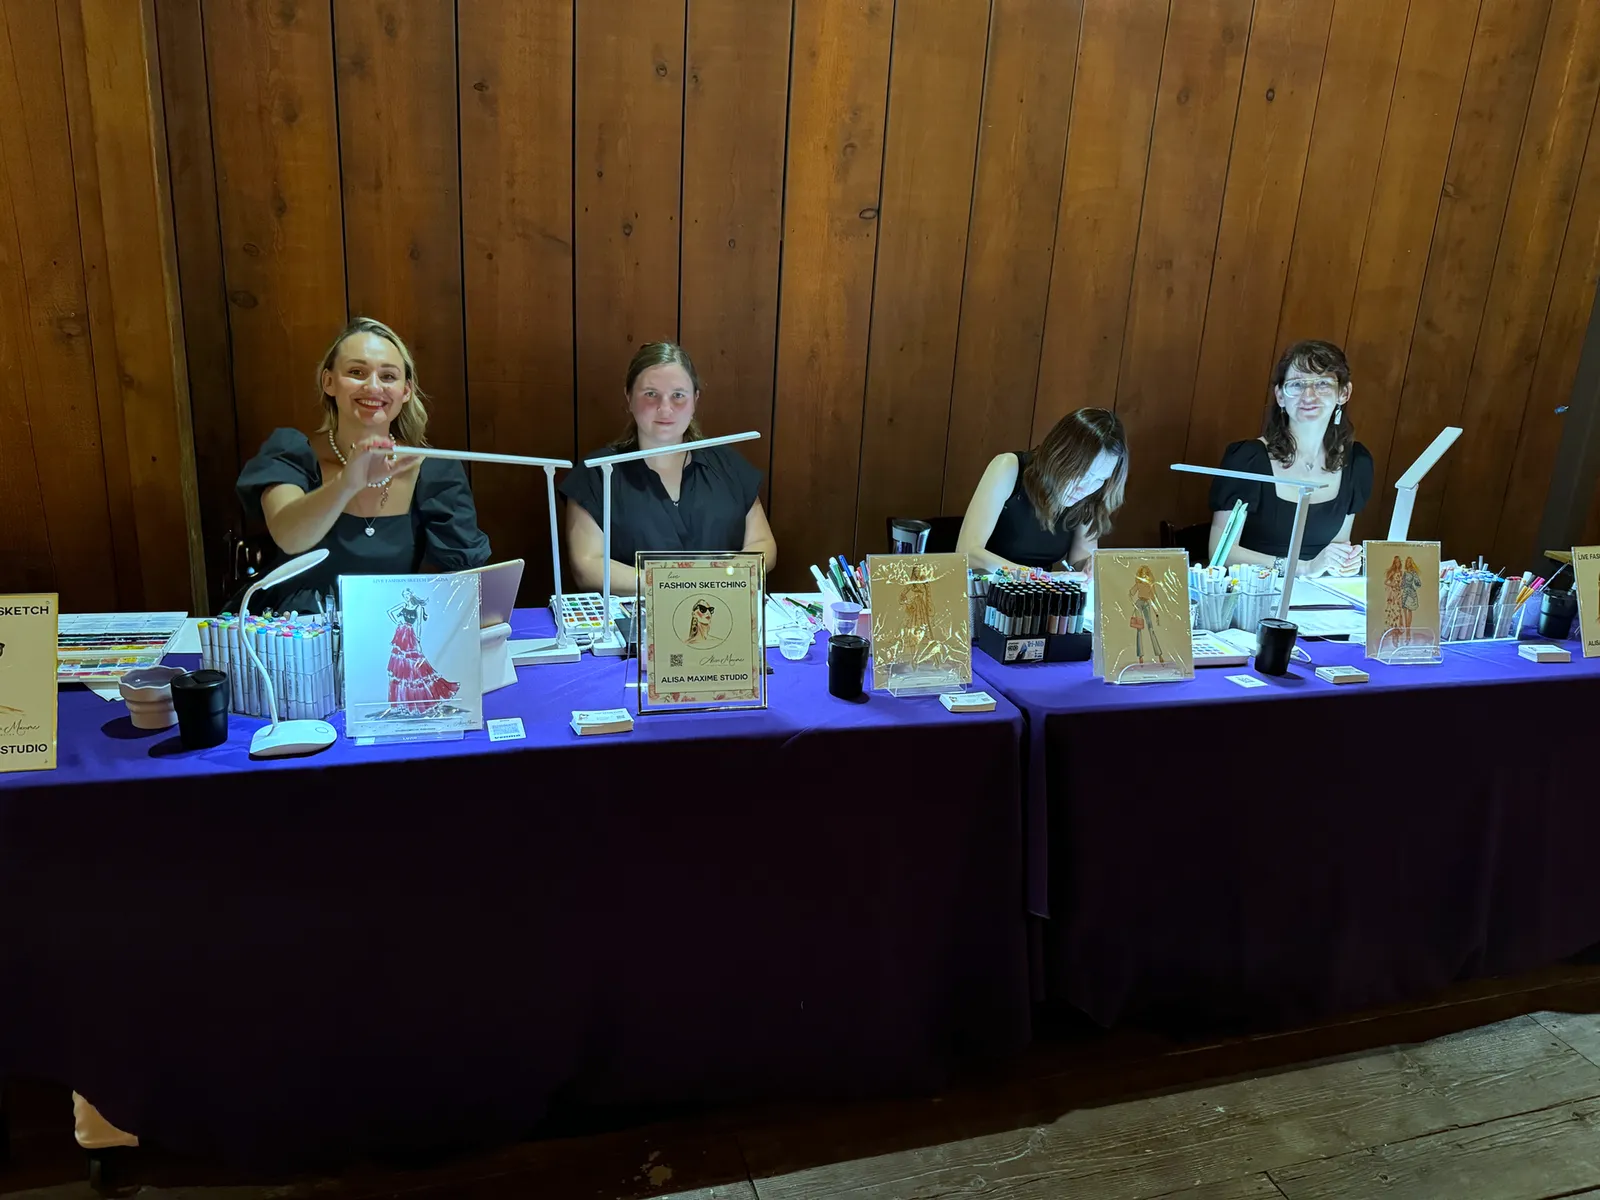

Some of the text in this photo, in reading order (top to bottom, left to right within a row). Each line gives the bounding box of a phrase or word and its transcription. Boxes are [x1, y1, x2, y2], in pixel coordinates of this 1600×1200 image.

[1577, 552, 1589, 561] LIVE
[659, 580, 747, 590] FASHION SKETCHING
[661, 673, 749, 684] ALISA MAXIME STUDIO
[0, 743, 48, 755] STUDIO
